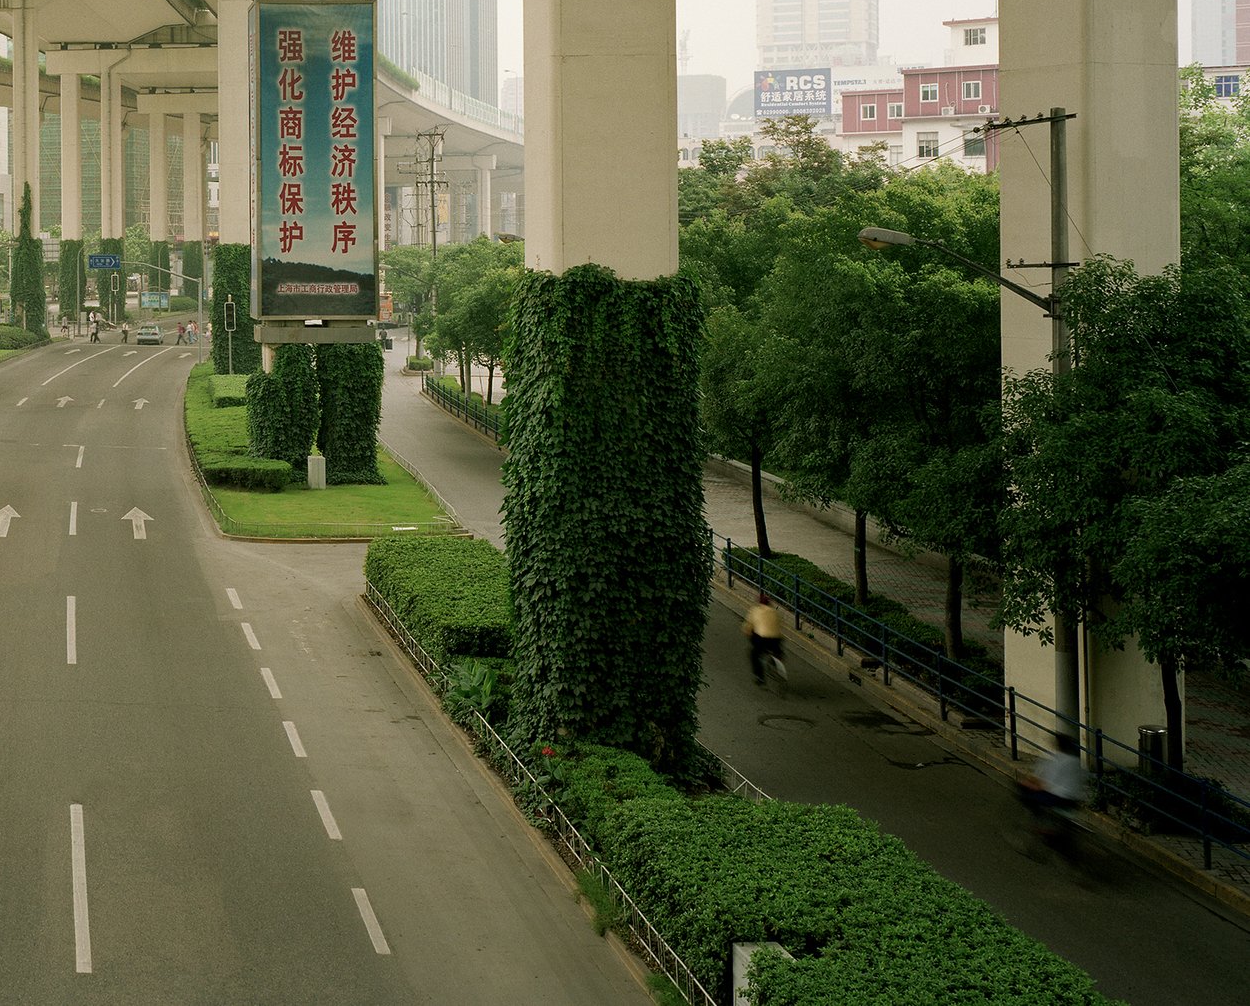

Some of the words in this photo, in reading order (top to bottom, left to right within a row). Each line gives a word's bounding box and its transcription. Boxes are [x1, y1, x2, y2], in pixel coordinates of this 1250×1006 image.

[786, 75, 826, 90] RCS
[761, 90, 827, 102] 舒适家居系统
[278, 30, 303, 254] 强化商标保护
[331, 30, 357, 254] 维护经济秩序
[277, 284, 358, 293] 上海市工商行政管理局
